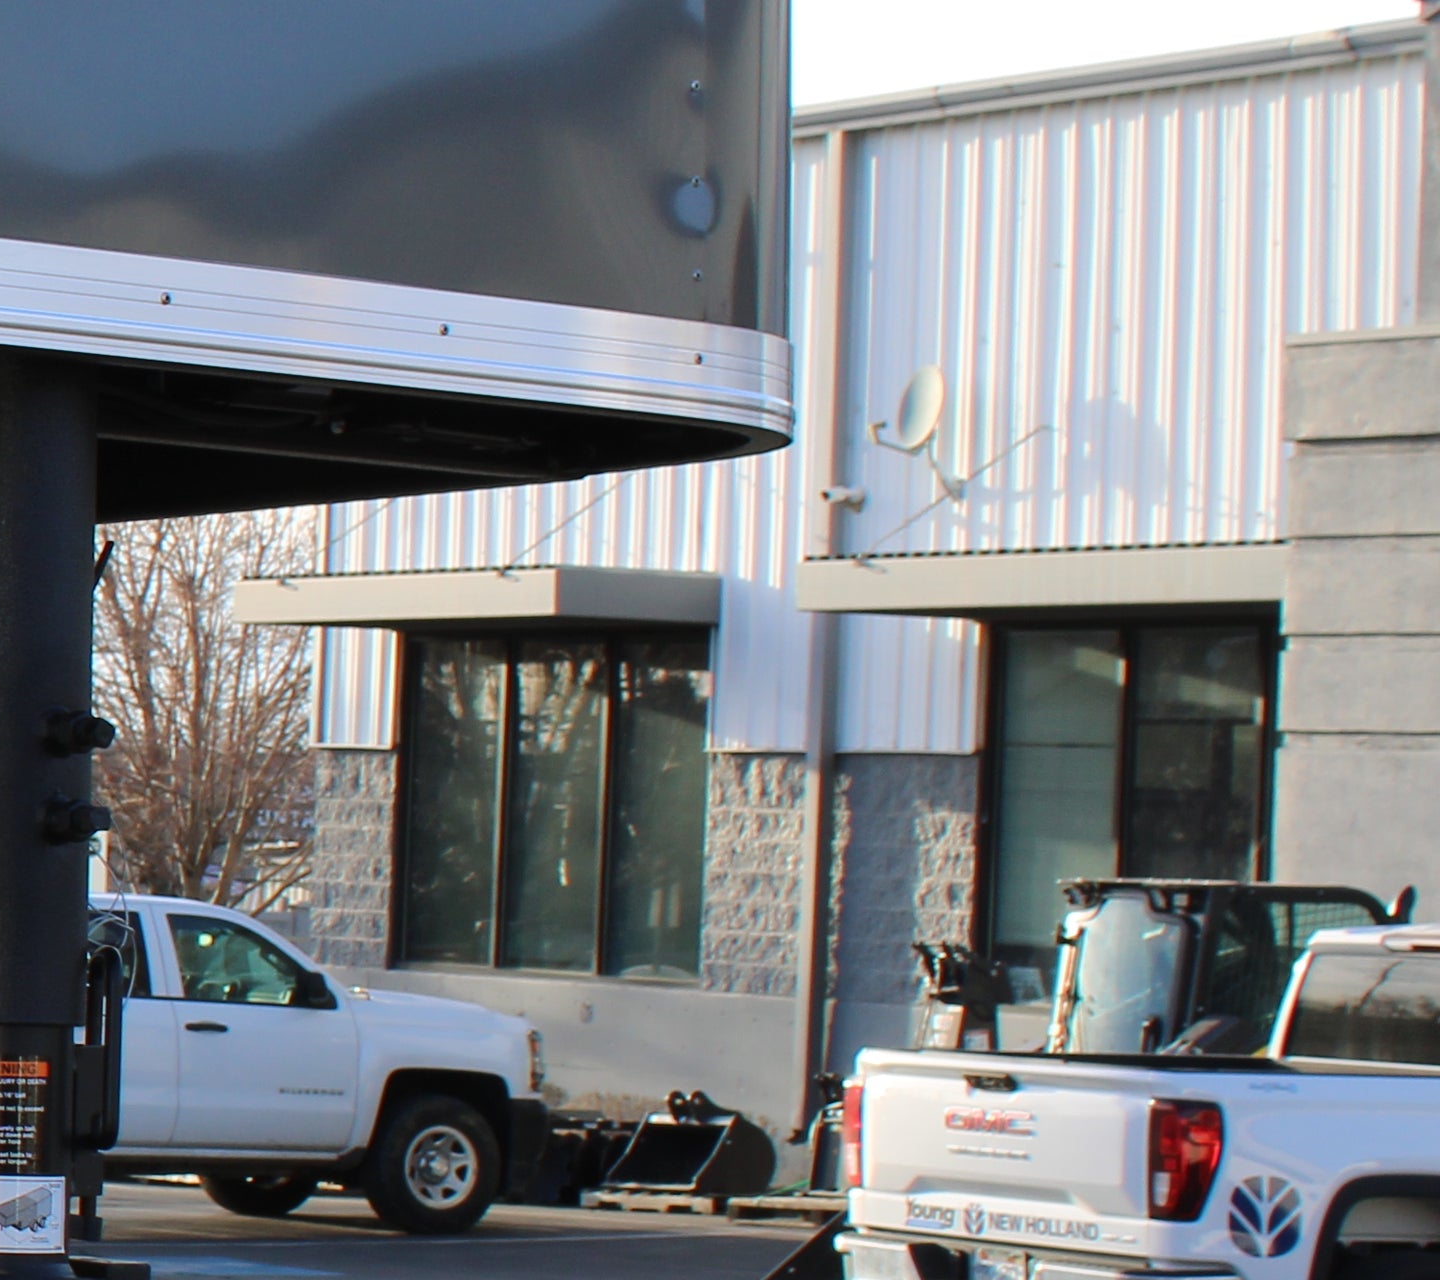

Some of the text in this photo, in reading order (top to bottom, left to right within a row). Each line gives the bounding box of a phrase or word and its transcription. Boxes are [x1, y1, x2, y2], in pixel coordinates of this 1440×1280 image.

[944, 1106, 1034, 1136] GMC
[905, 1198, 955, 1228] Young
[988, 1212, 1022, 1234] NEW
[1024, 1217, 1099, 1241] HOLLAND
